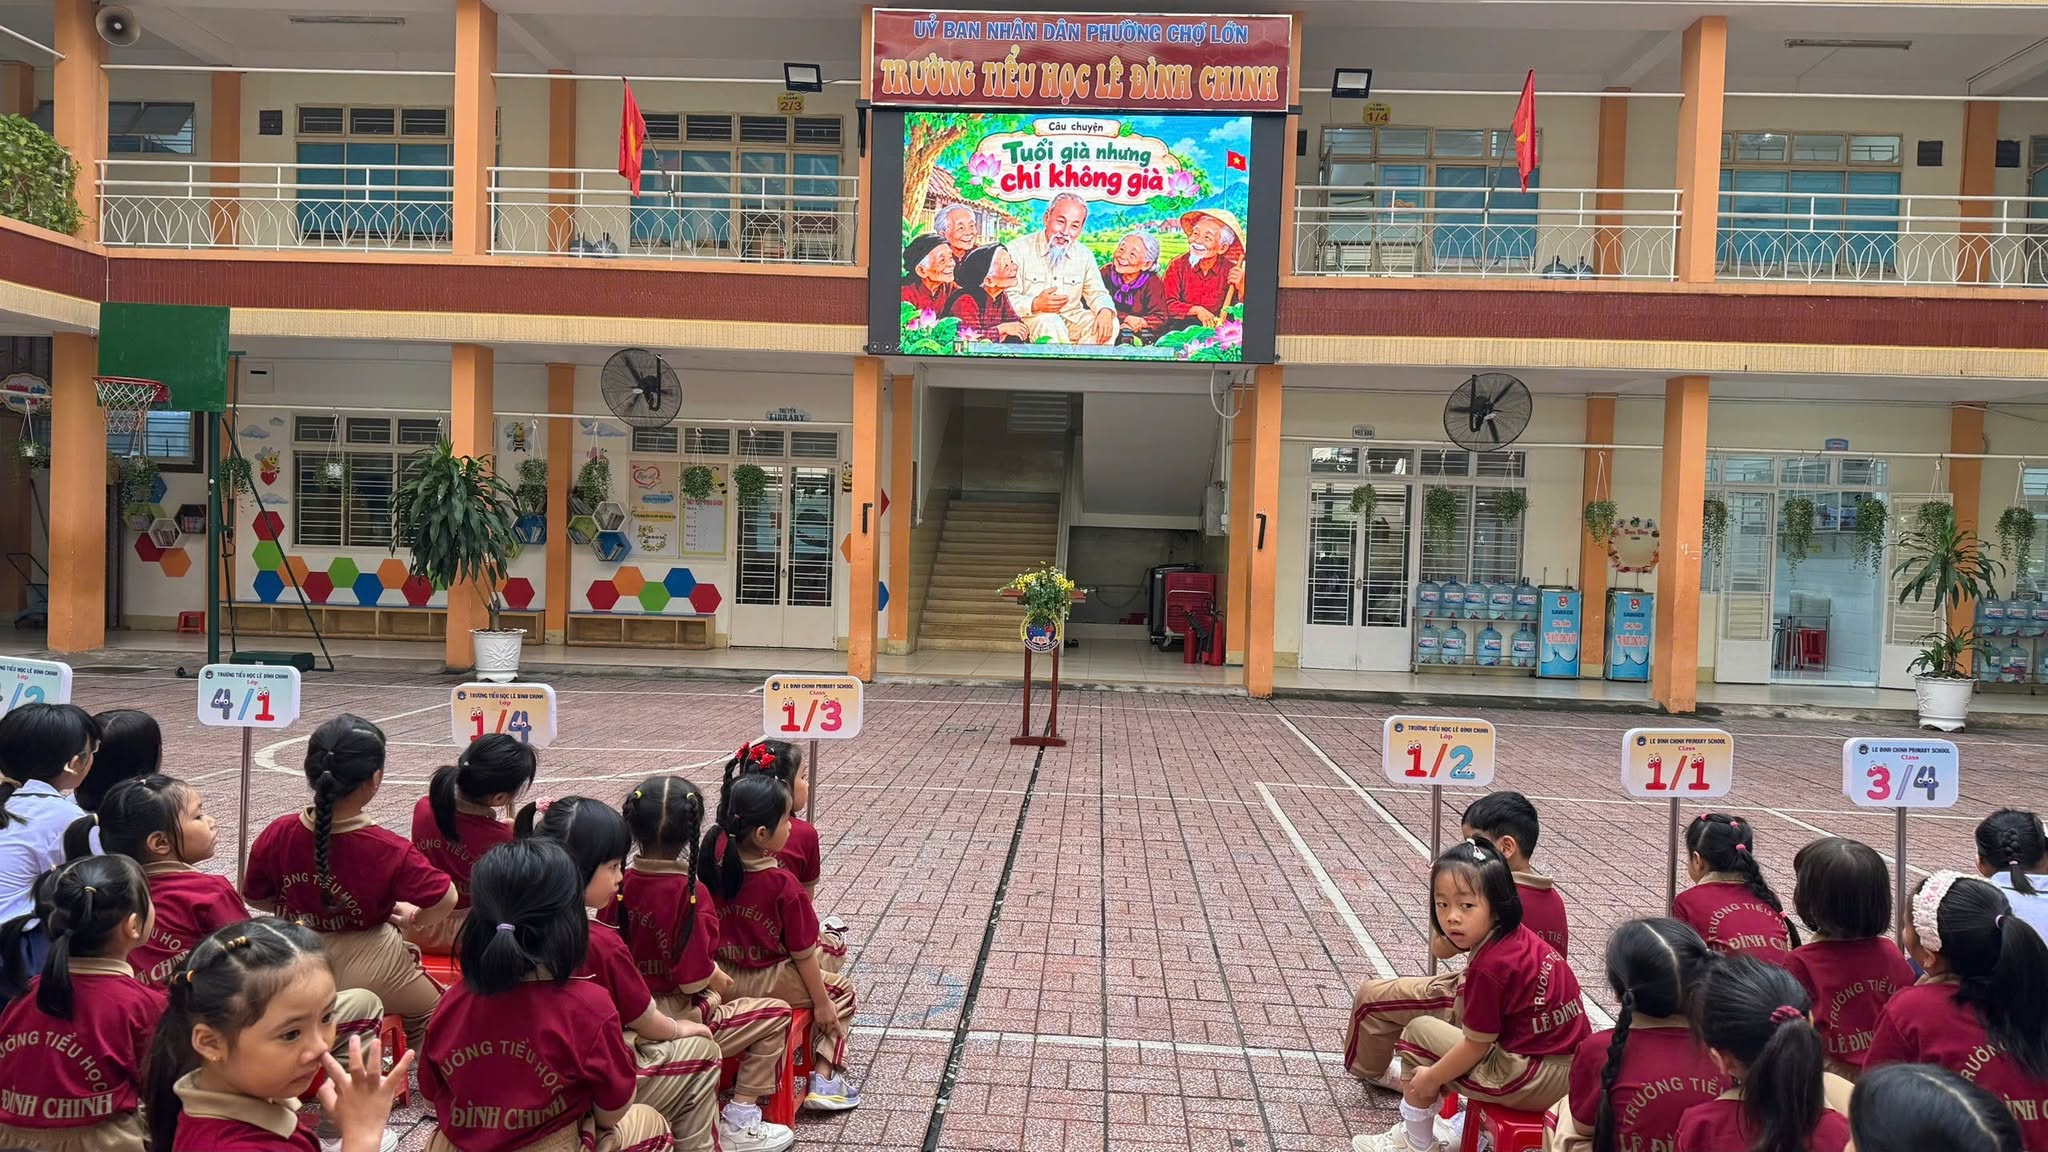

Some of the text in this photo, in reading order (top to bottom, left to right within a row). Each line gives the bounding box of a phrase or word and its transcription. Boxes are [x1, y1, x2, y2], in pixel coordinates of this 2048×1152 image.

[942, 20, 980, 40] BAN
[986, 18, 1036, 41] NHÂN
[1043, 18, 1082, 42] DÂN
[1086, 20, 1162, 43] PHƯỜNG
[1166, 22, 1206, 47] CHỢ
[1210, 22, 1248, 44] LỚN
[881, 45, 1280, 105] TRƯỜNG TIỂU HỌC LÊ ĐÌNH CHINH
[780, 102, 802, 111] 2/3
[1368, 112, 1389, 121] 1/4
[1048, 122, 1104, 133] Câu chuyện
[1002, 138, 1152, 167] Tuổi già nhưng
[1000, 162, 1164, 197] chí không già
[210, 687, 275, 721] 4/1
[780, 698, 843, 732] 1/3
[470, 708, 532, 744] 1/4
[1405, 742, 1476, 779] 1/2
[1646, 755, 1710, 790] 1/1
[1866, 764, 1939, 800] 3/4
[1728, 932, 1768, 950] ĐÌNH
[1532, 999, 1584, 1034] LÊ ĐÌNH
[1830, 982, 1865, 1030] TRƯỜNG
[500, 1038, 537, 1064] TIỂU
[1828, 1027, 1874, 1054] LÊ ĐÌN
[46, 1031, 83, 1059] TIỂU
[79, 1055, 108, 1093] HỌC
[2, 1084, 113, 1120] ĐÌNH CHINH
[450, 1092, 569, 1131] ĐÌNH CHINH
[1623, 1076, 1685, 1127] TRƯỜNG
[1650, 1132, 1675, 1152] ĐÌ
